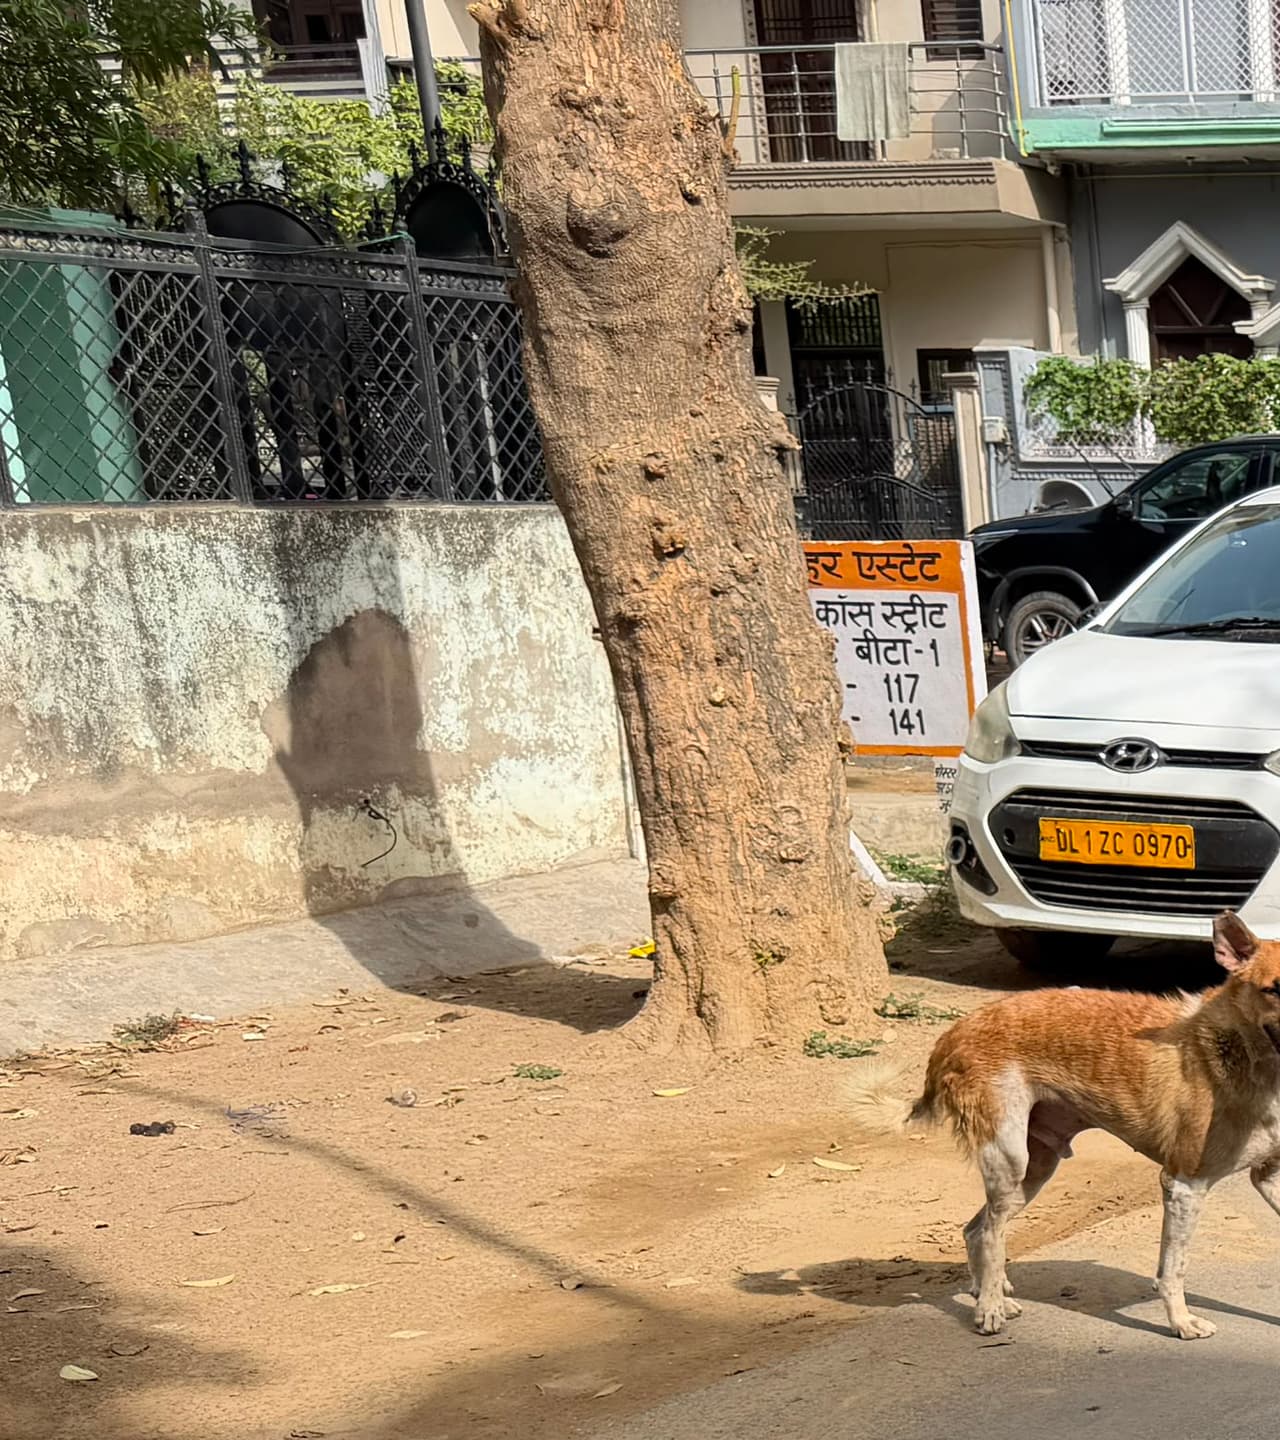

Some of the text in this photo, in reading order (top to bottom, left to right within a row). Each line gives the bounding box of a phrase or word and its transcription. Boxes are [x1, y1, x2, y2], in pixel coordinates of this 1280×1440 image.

[852, 543, 941, 582] एस्टेट
[881, 593, 948, 635] स्ट्रीट
[883, 673, 919, 704] 117
[889, 708, 925, 736] 141
[1133, 832, 1188, 859] 0970
